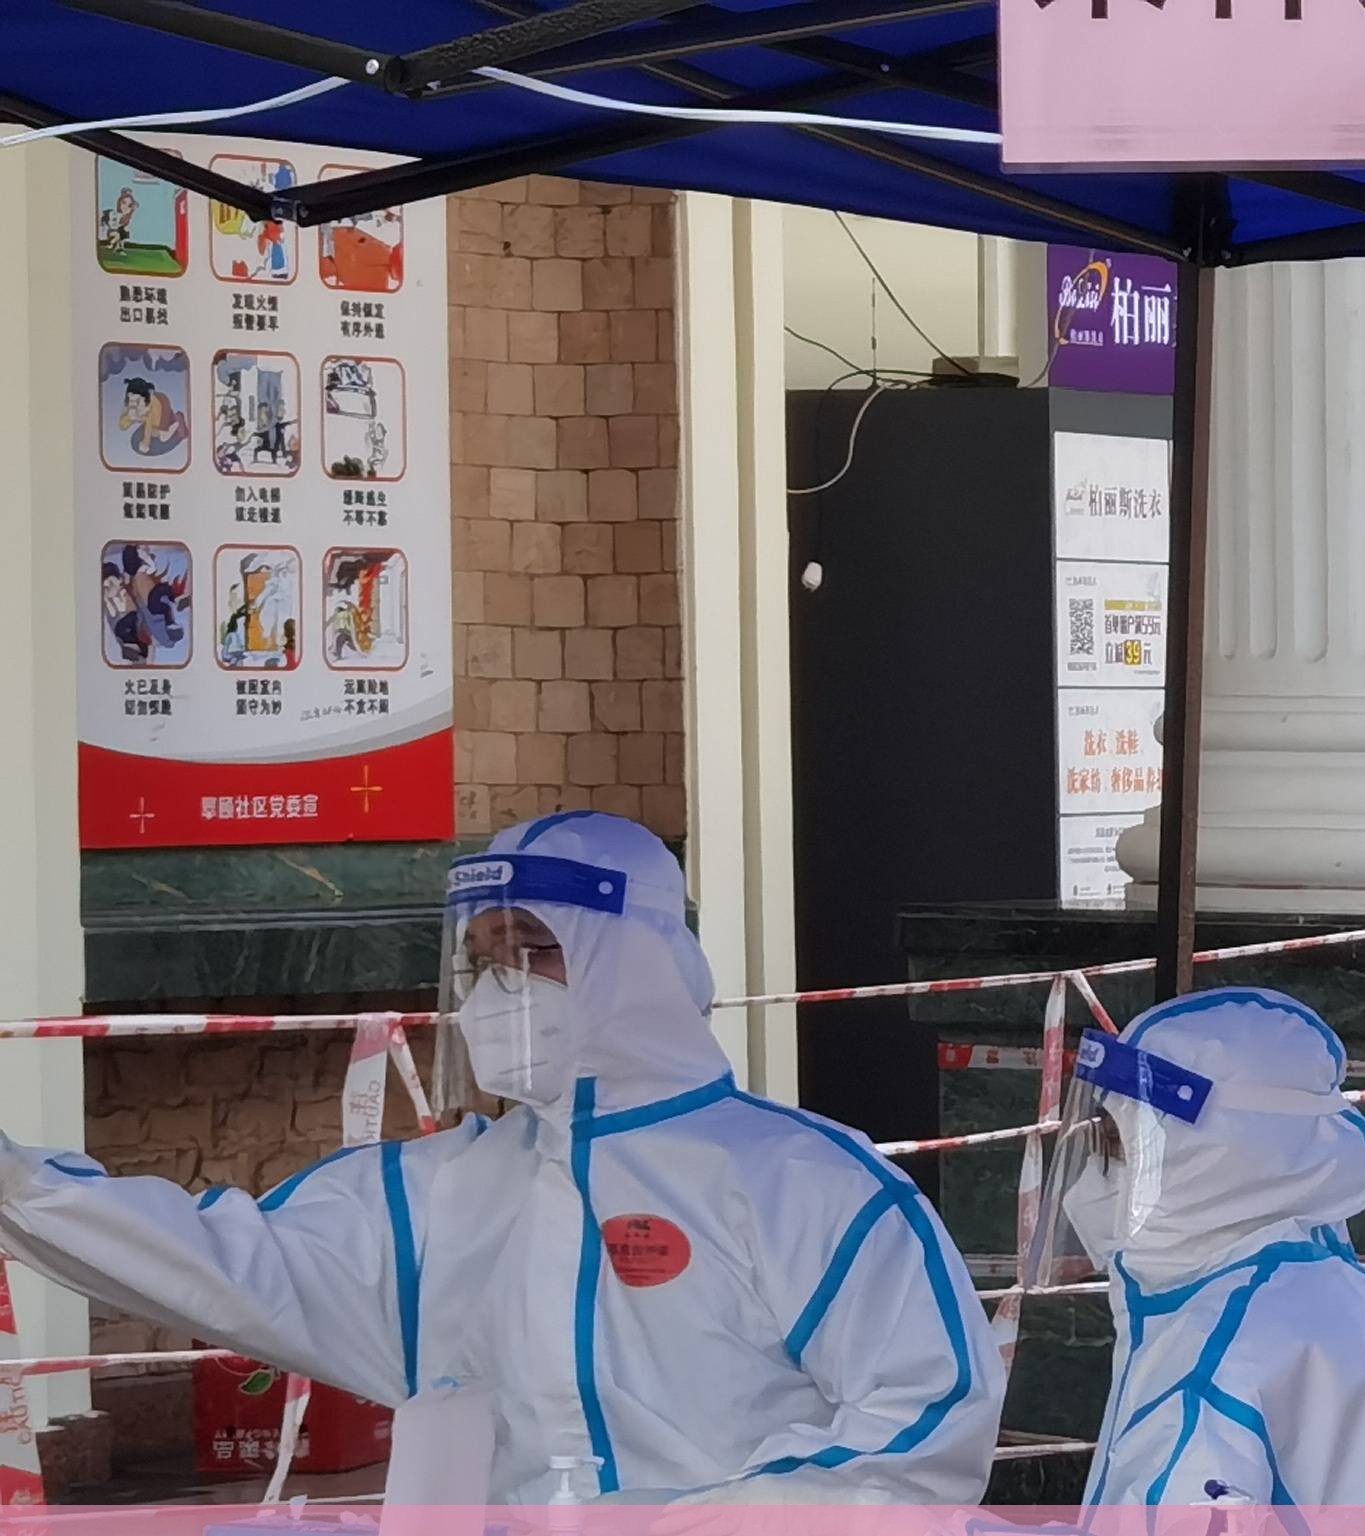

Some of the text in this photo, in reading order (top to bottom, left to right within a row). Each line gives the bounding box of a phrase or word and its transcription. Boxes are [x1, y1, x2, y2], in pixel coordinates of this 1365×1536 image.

[1110, 277, 1177, 345] 柏丽
[1089, 483, 1163, 520] 柏丽斯洗衣
